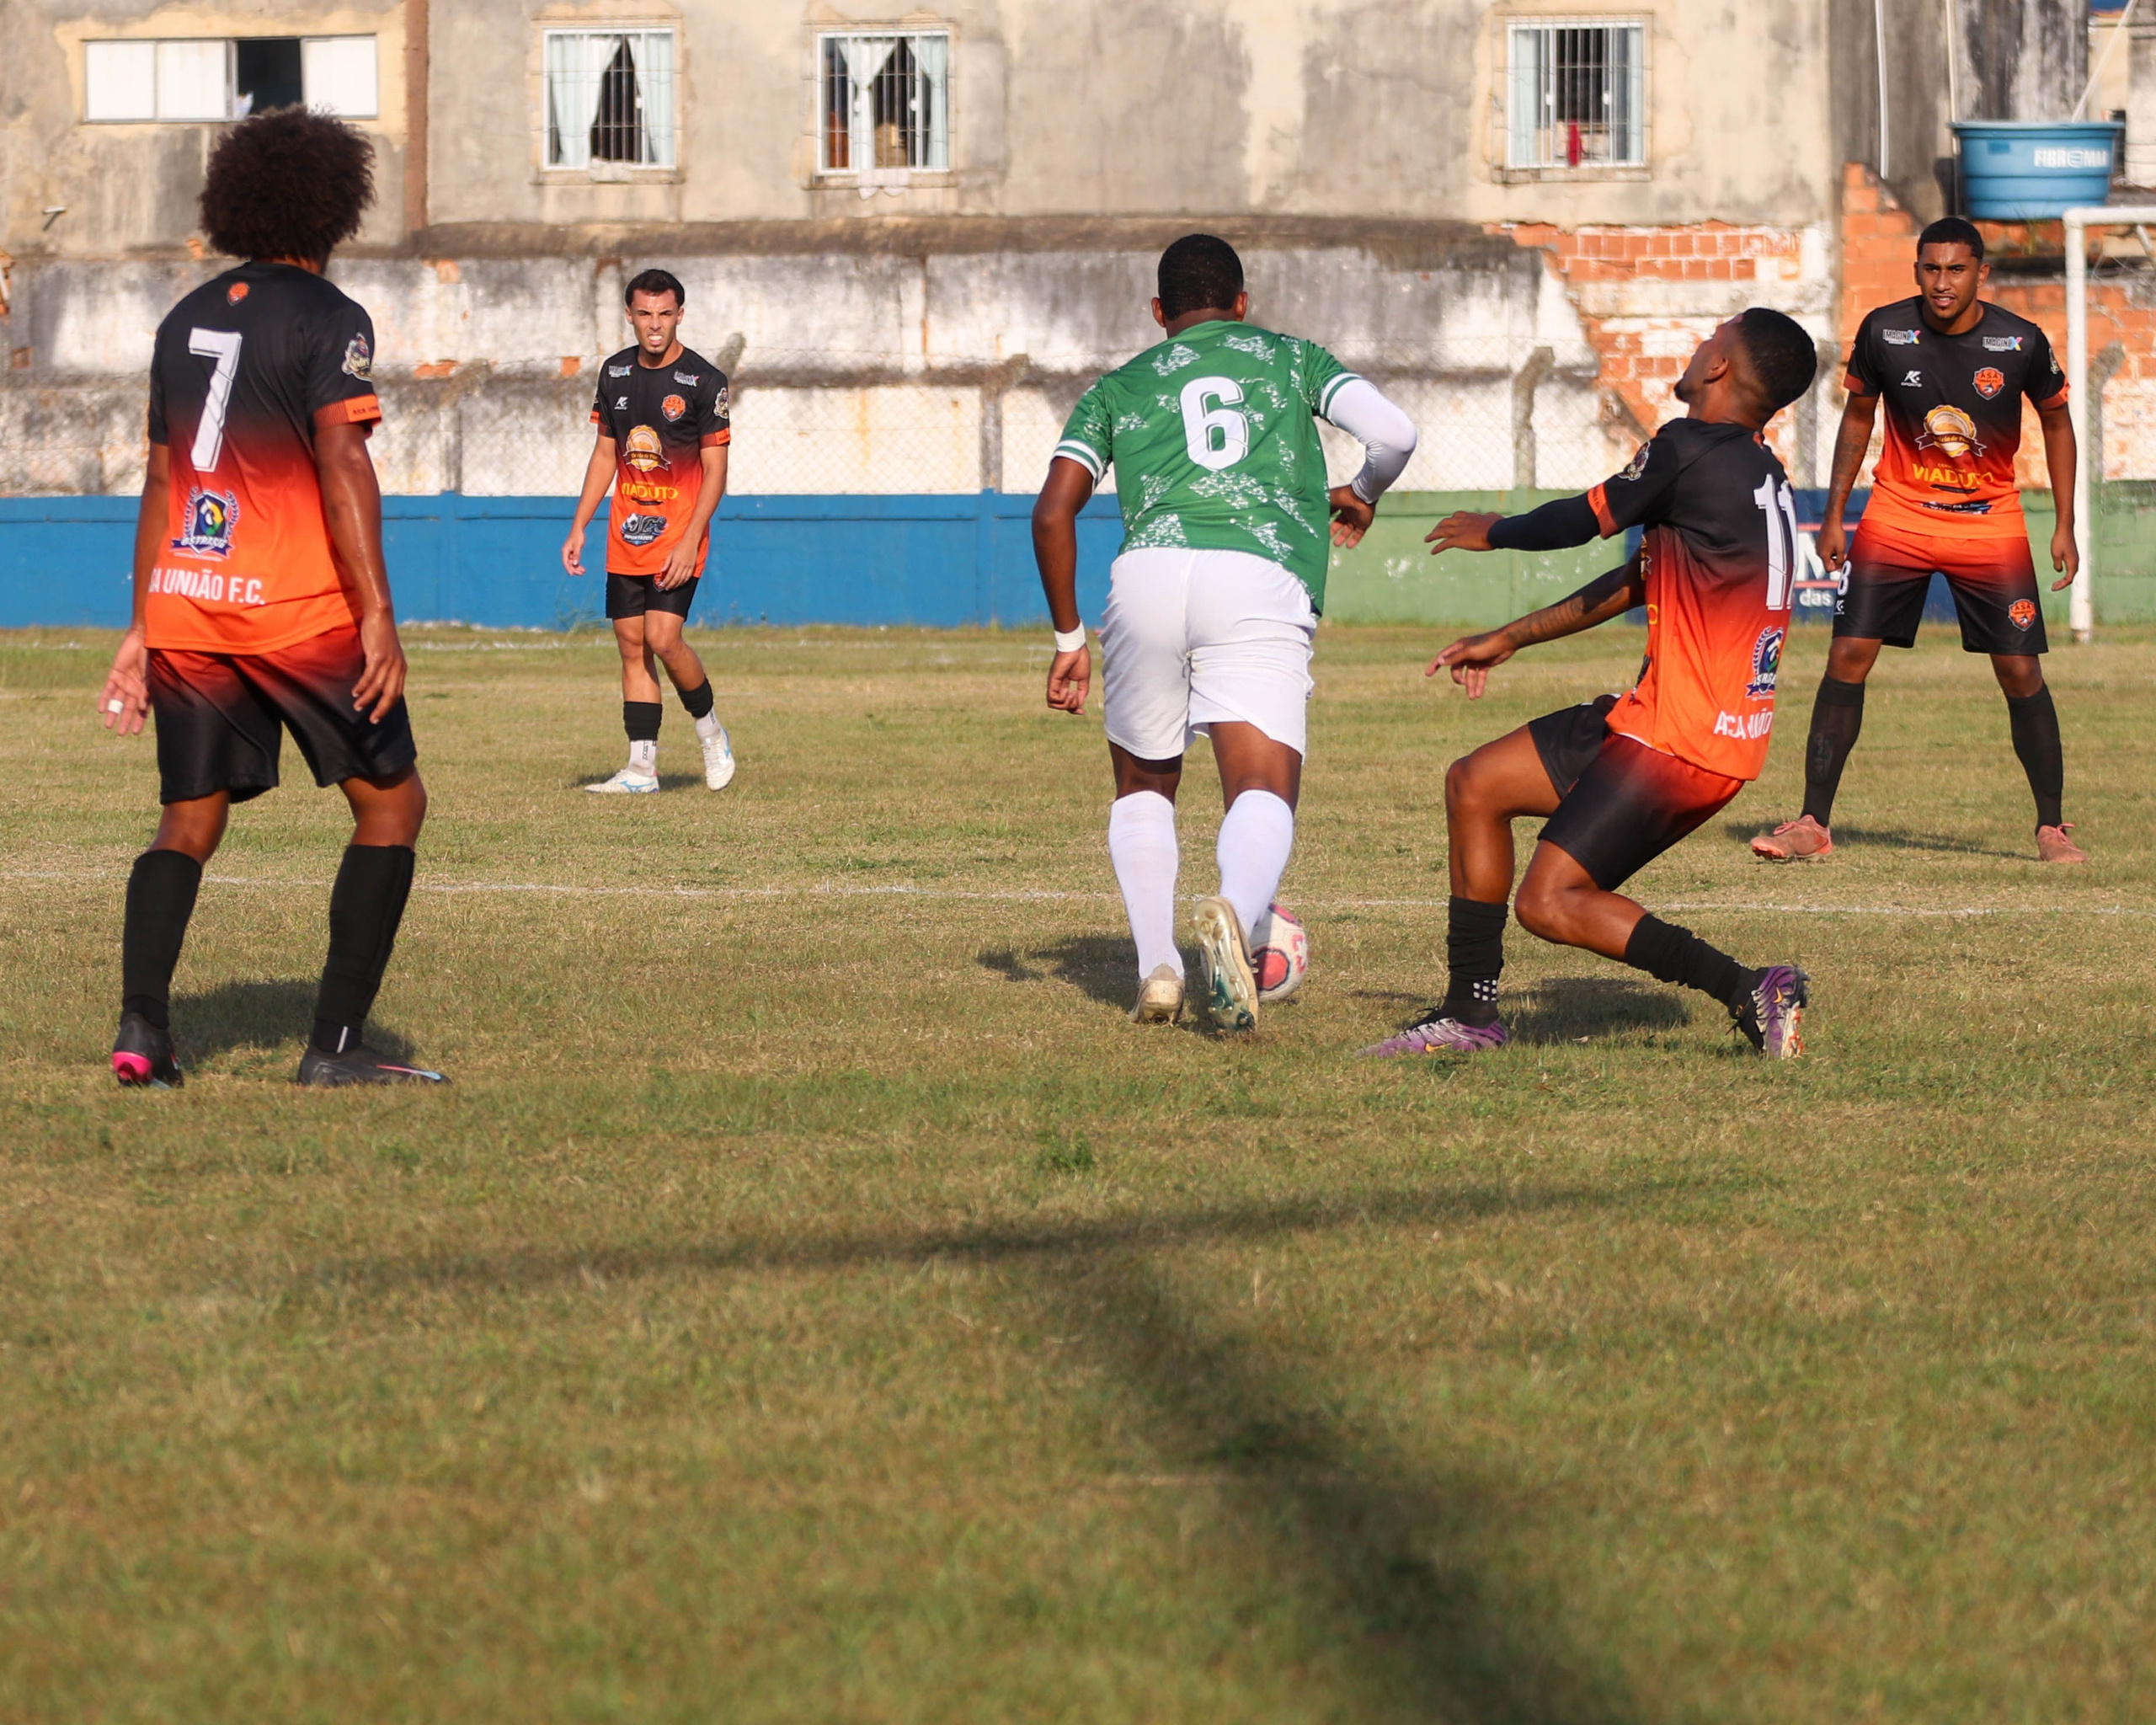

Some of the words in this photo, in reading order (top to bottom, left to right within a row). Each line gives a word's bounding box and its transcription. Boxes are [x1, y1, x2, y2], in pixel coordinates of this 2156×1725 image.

[188, 328, 243, 473] 7
[1180, 376, 1249, 472] 6
[1753, 474, 1798, 611] 11
[163, 568, 224, 601] UNIÃO
[228, 576, 266, 605] F.C.
[1799, 587, 1833, 606] das
[1838, 560, 1852, 596] 8
